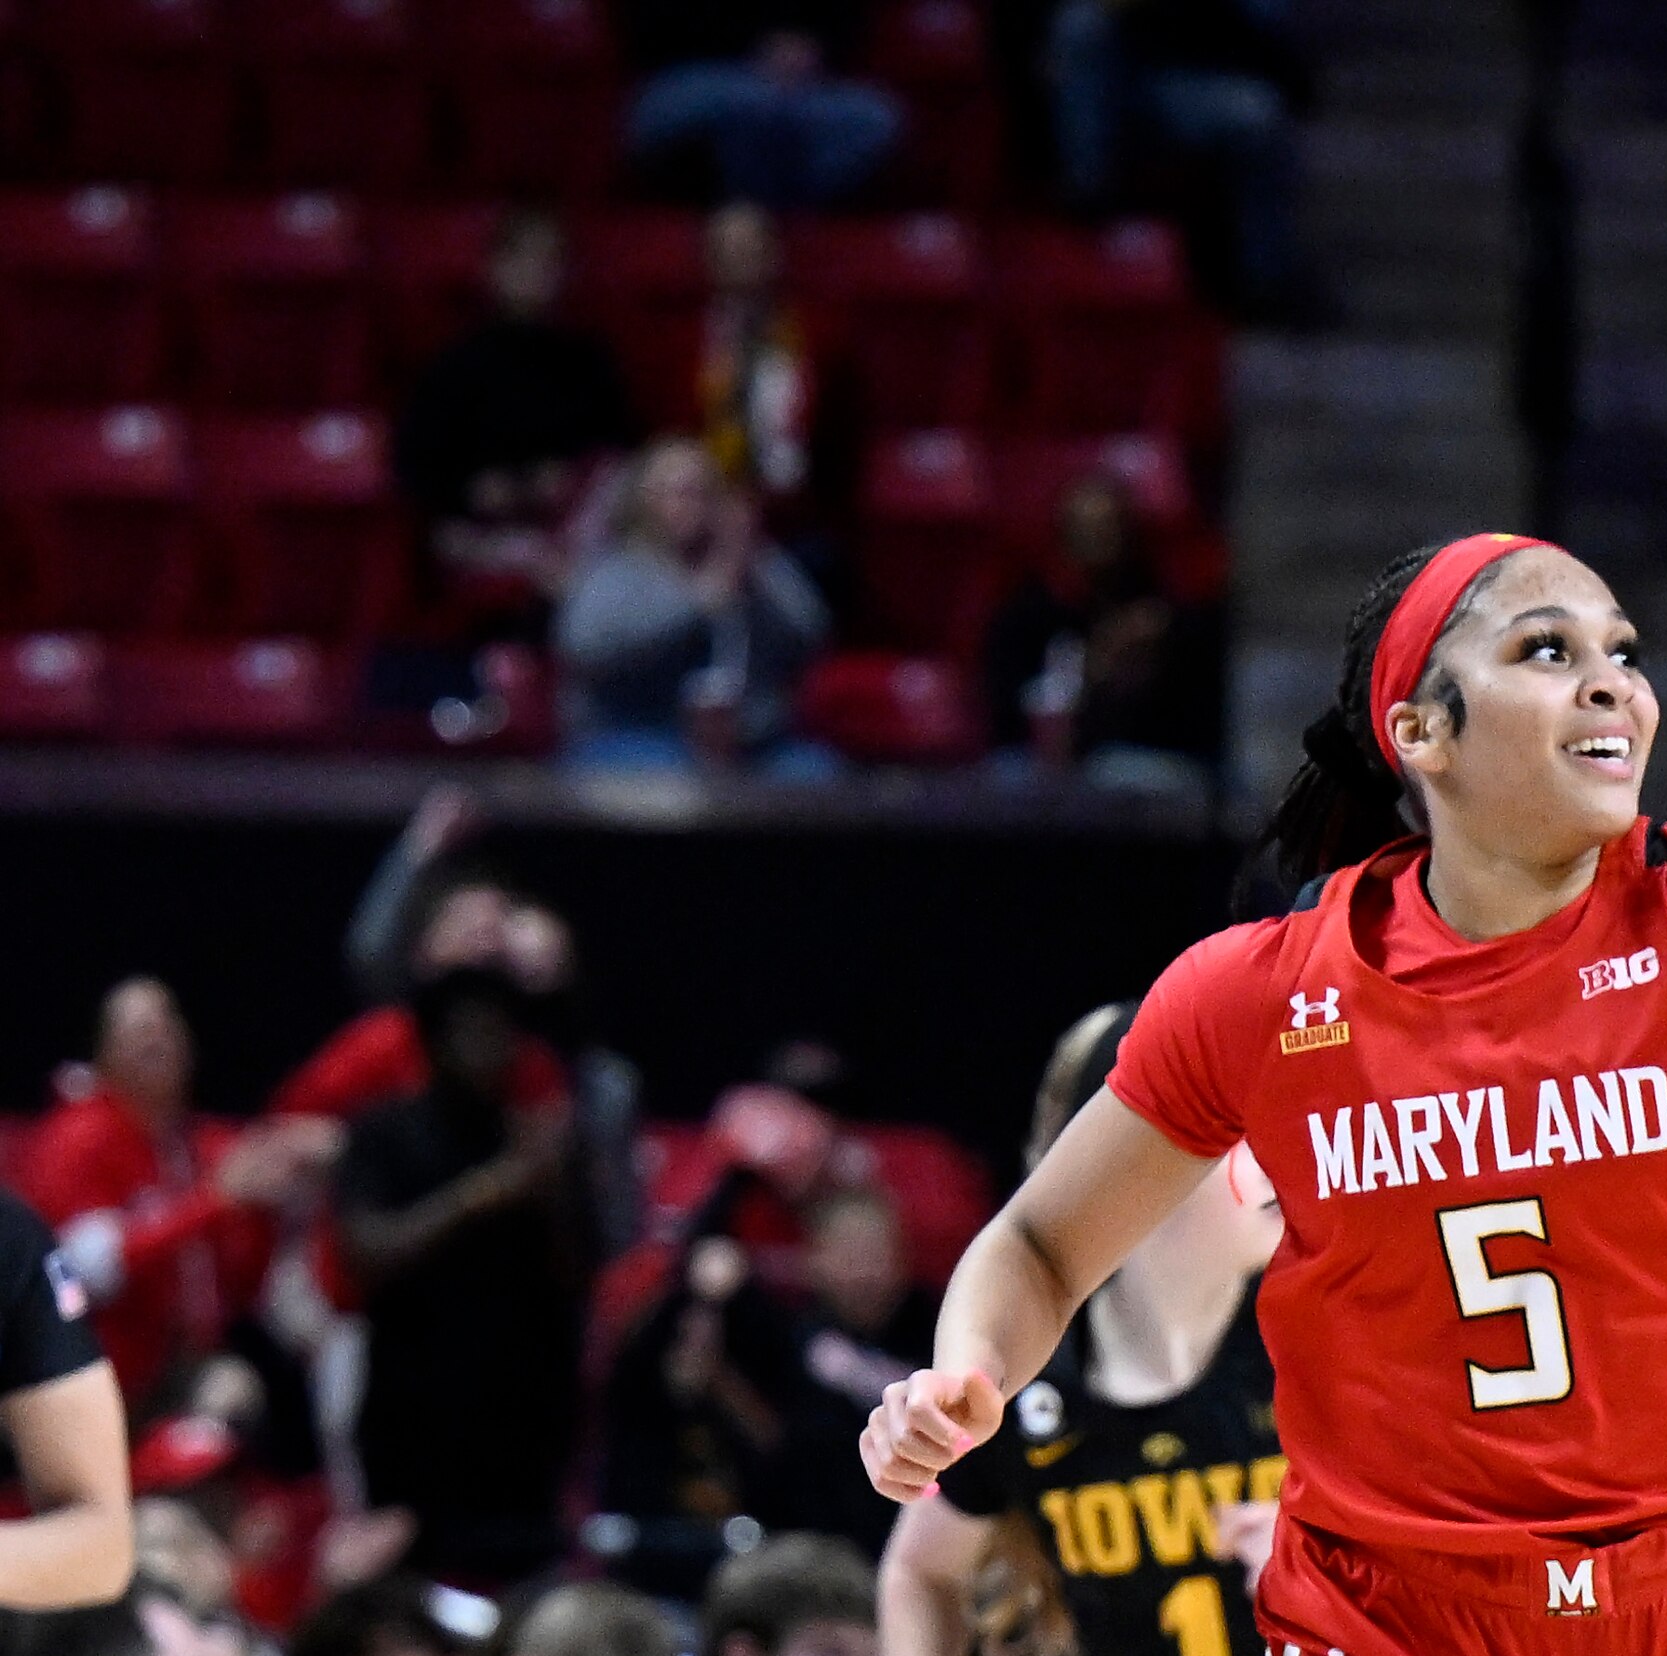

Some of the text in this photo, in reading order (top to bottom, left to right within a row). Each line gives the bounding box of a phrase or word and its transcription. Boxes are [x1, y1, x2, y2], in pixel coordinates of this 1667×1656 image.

[1284, 1023, 1346, 1051] GRADUATE
[1434, 1195, 1576, 1413] 5
[1544, 1557, 1599, 1610] M
